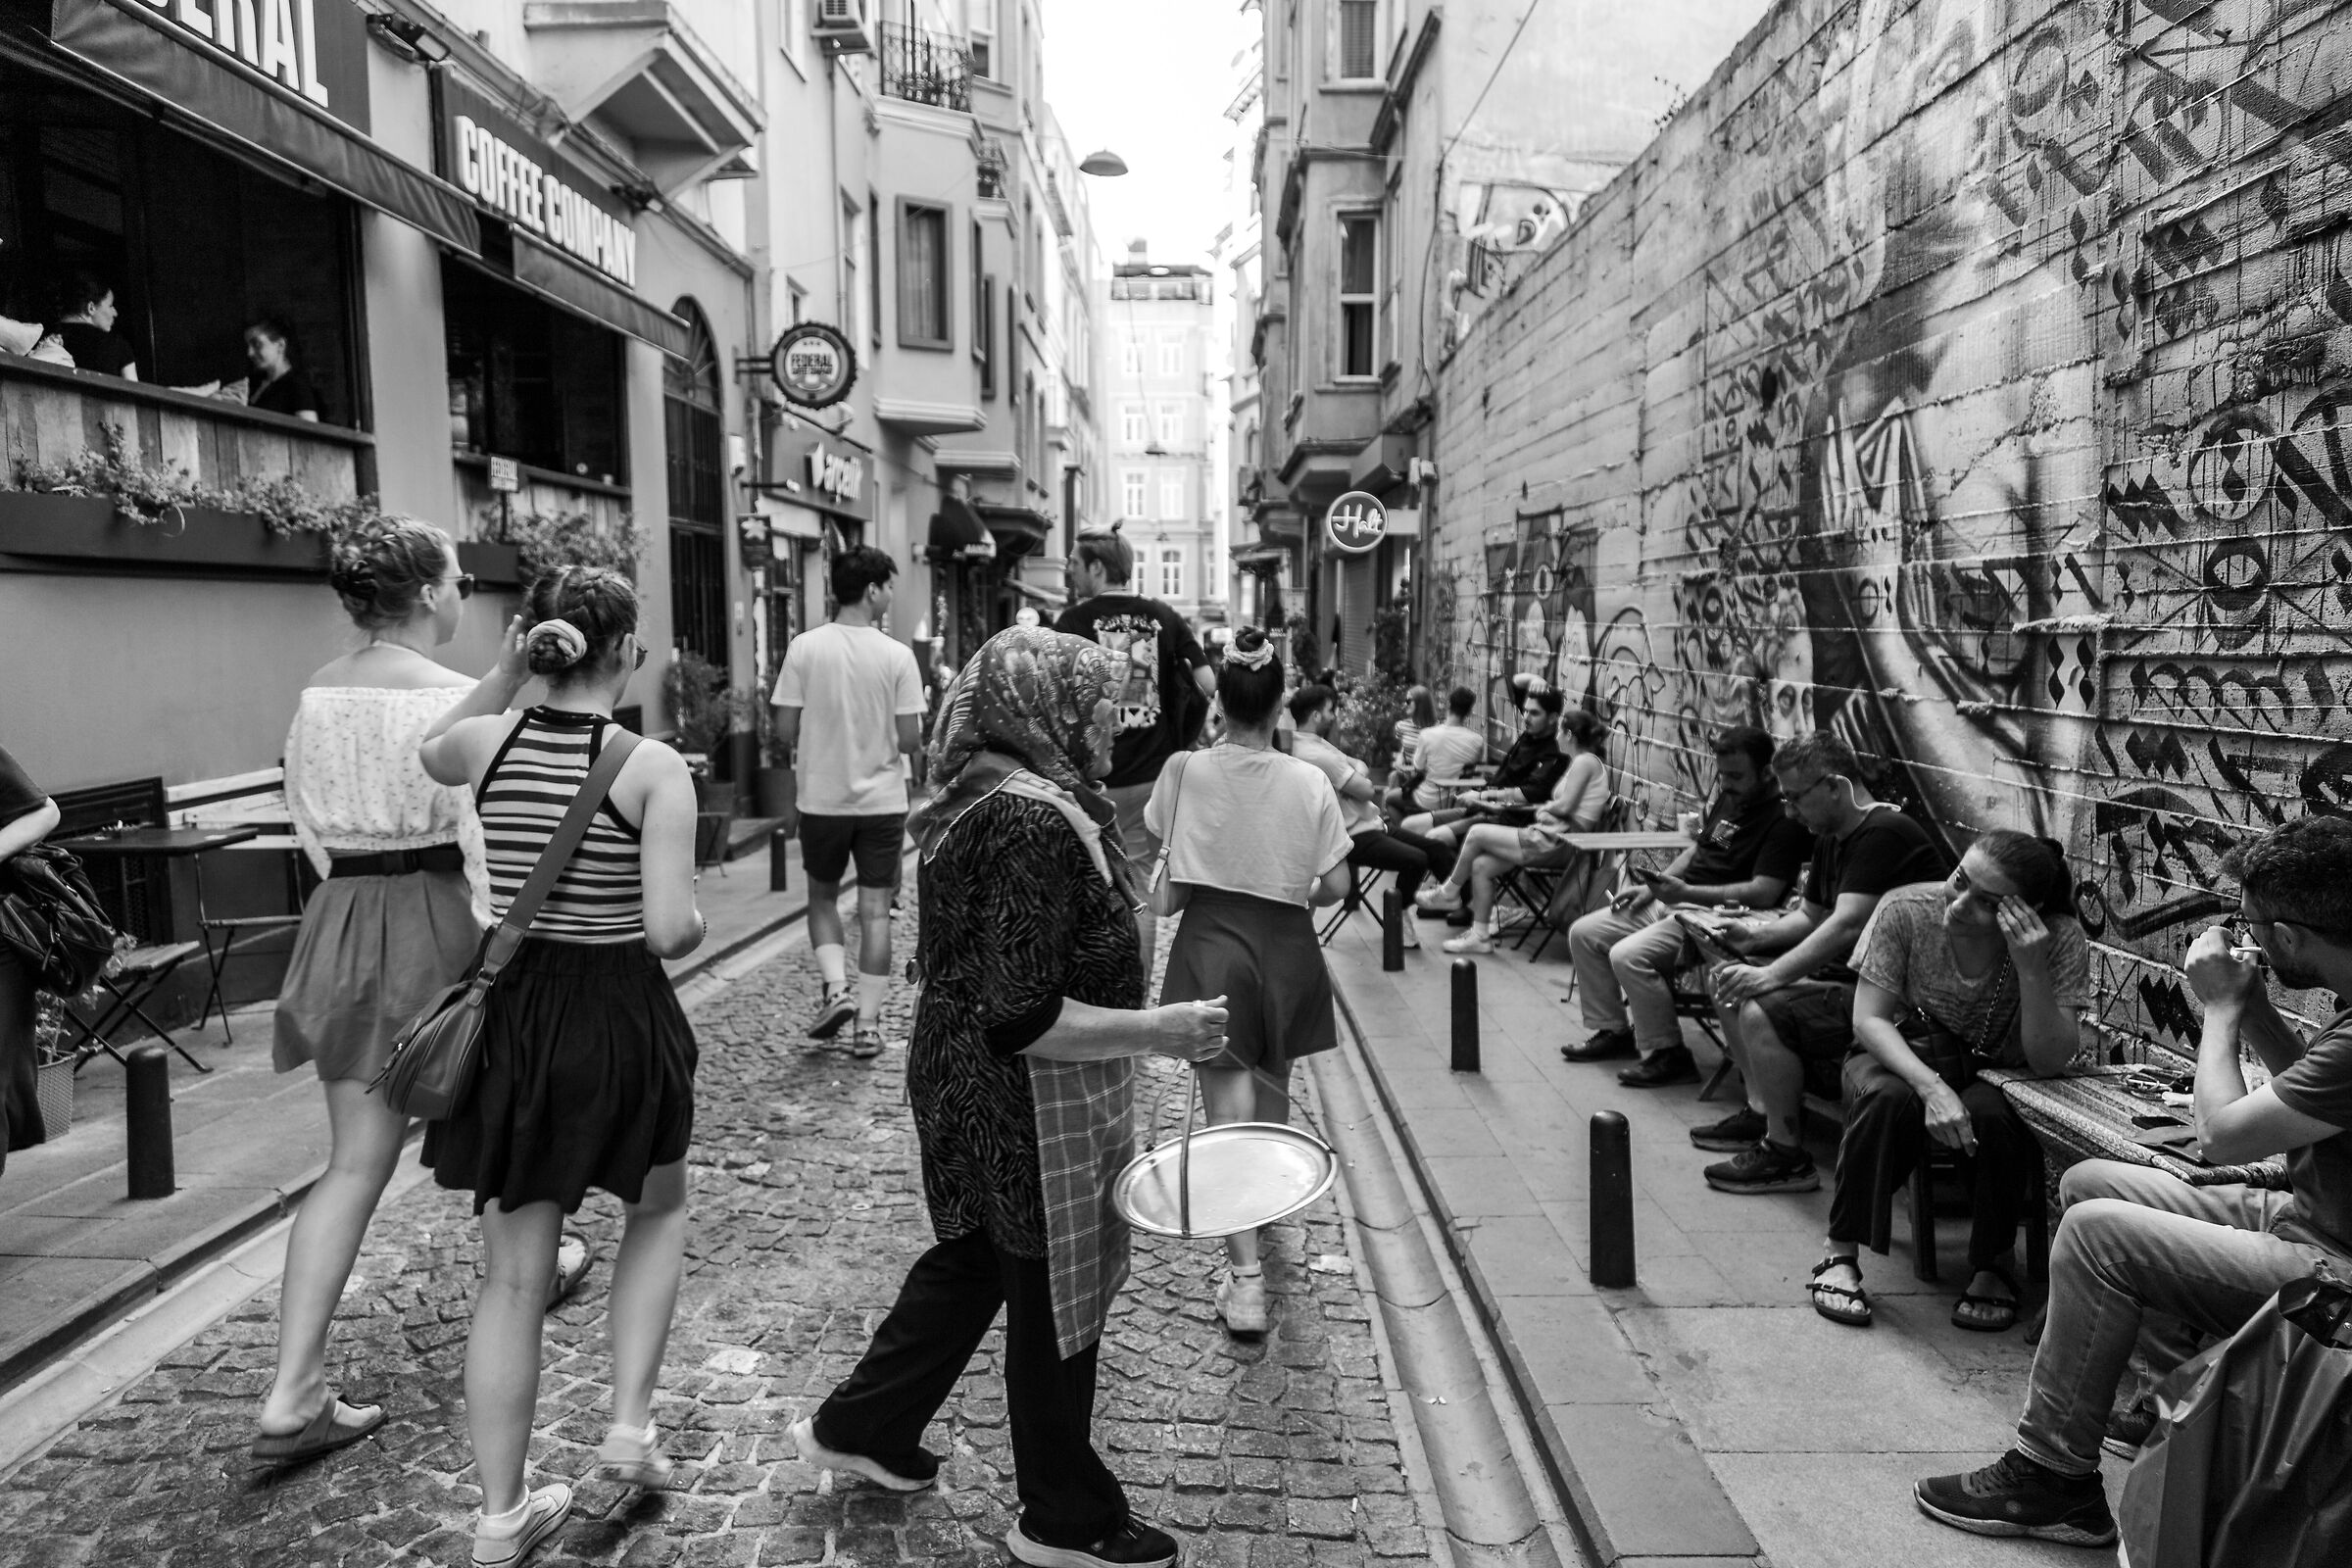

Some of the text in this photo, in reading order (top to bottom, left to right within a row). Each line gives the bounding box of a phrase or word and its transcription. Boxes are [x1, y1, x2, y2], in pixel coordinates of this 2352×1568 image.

[455, 116, 636, 287] COFFEE COMPANY
[791, 354, 833, 368] FEDERAL
